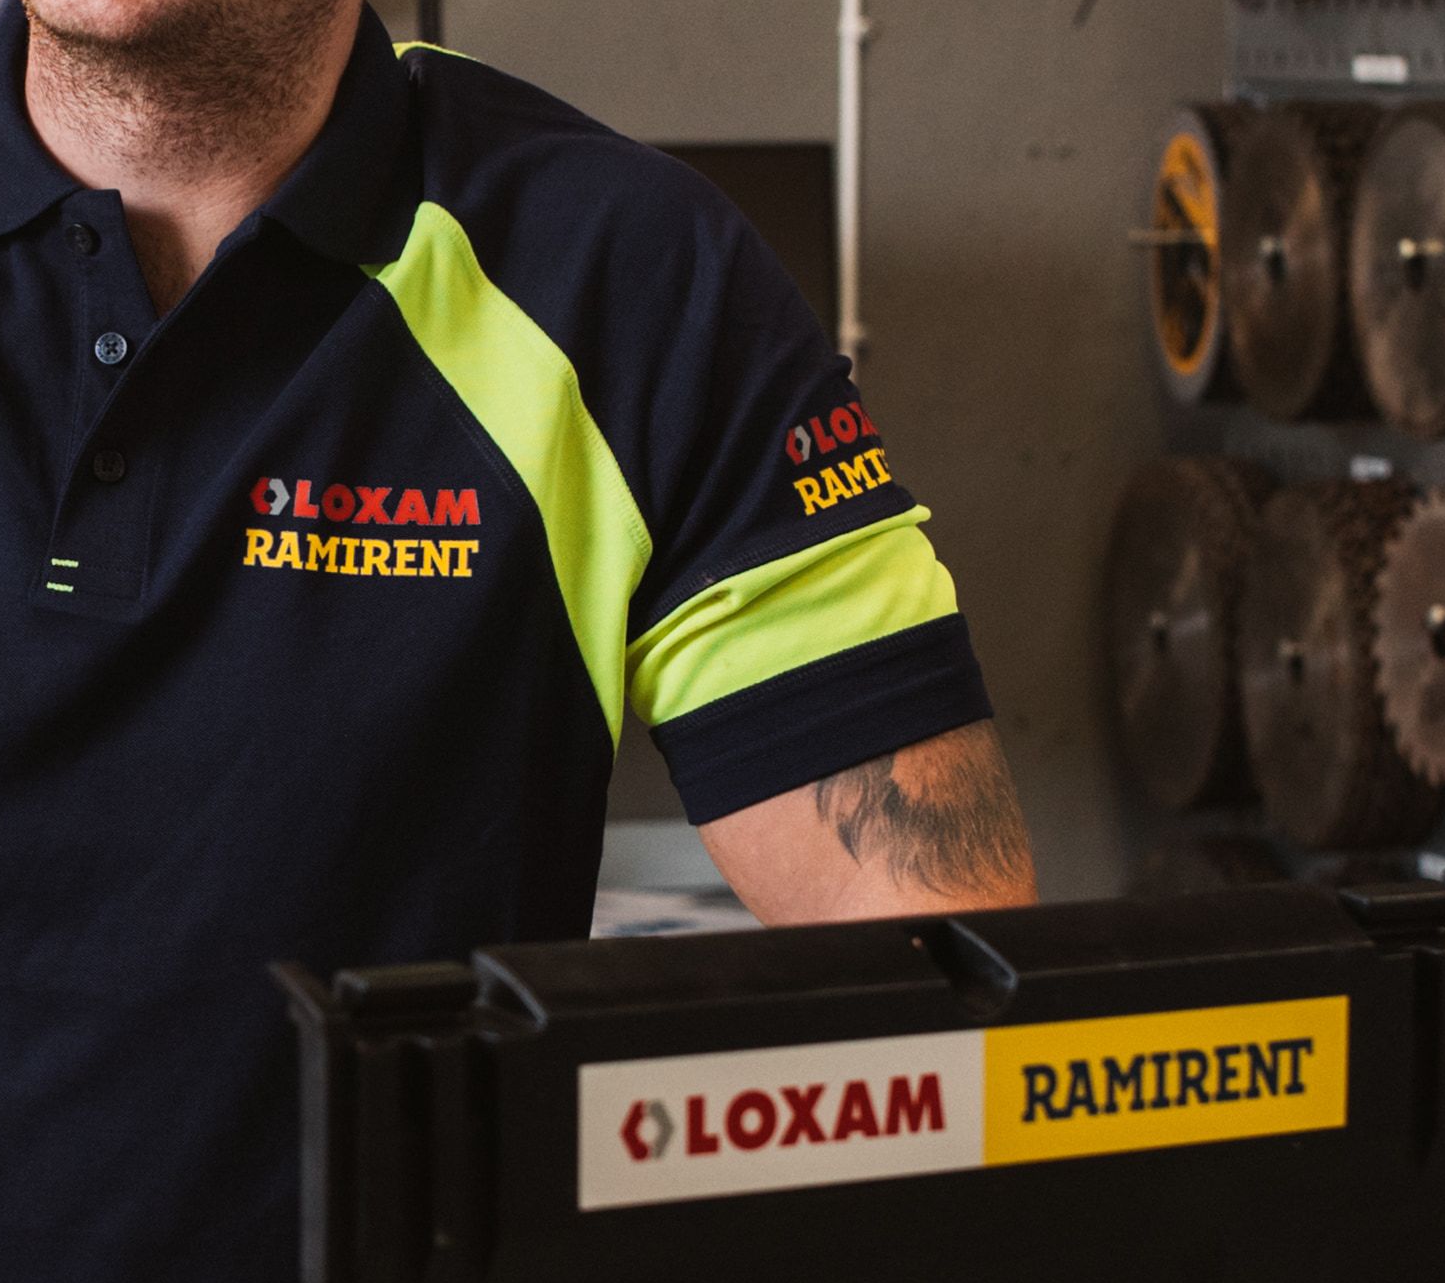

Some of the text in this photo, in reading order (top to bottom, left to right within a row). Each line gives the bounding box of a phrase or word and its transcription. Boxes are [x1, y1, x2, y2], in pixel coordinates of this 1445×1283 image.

[292, 478, 482, 527] LOXAM
[792, 446, 893, 517] RAMI
[242, 527, 480, 578] RAMIRENT
[685, 1036, 1315, 1157] LOXAM RAMIRENT
